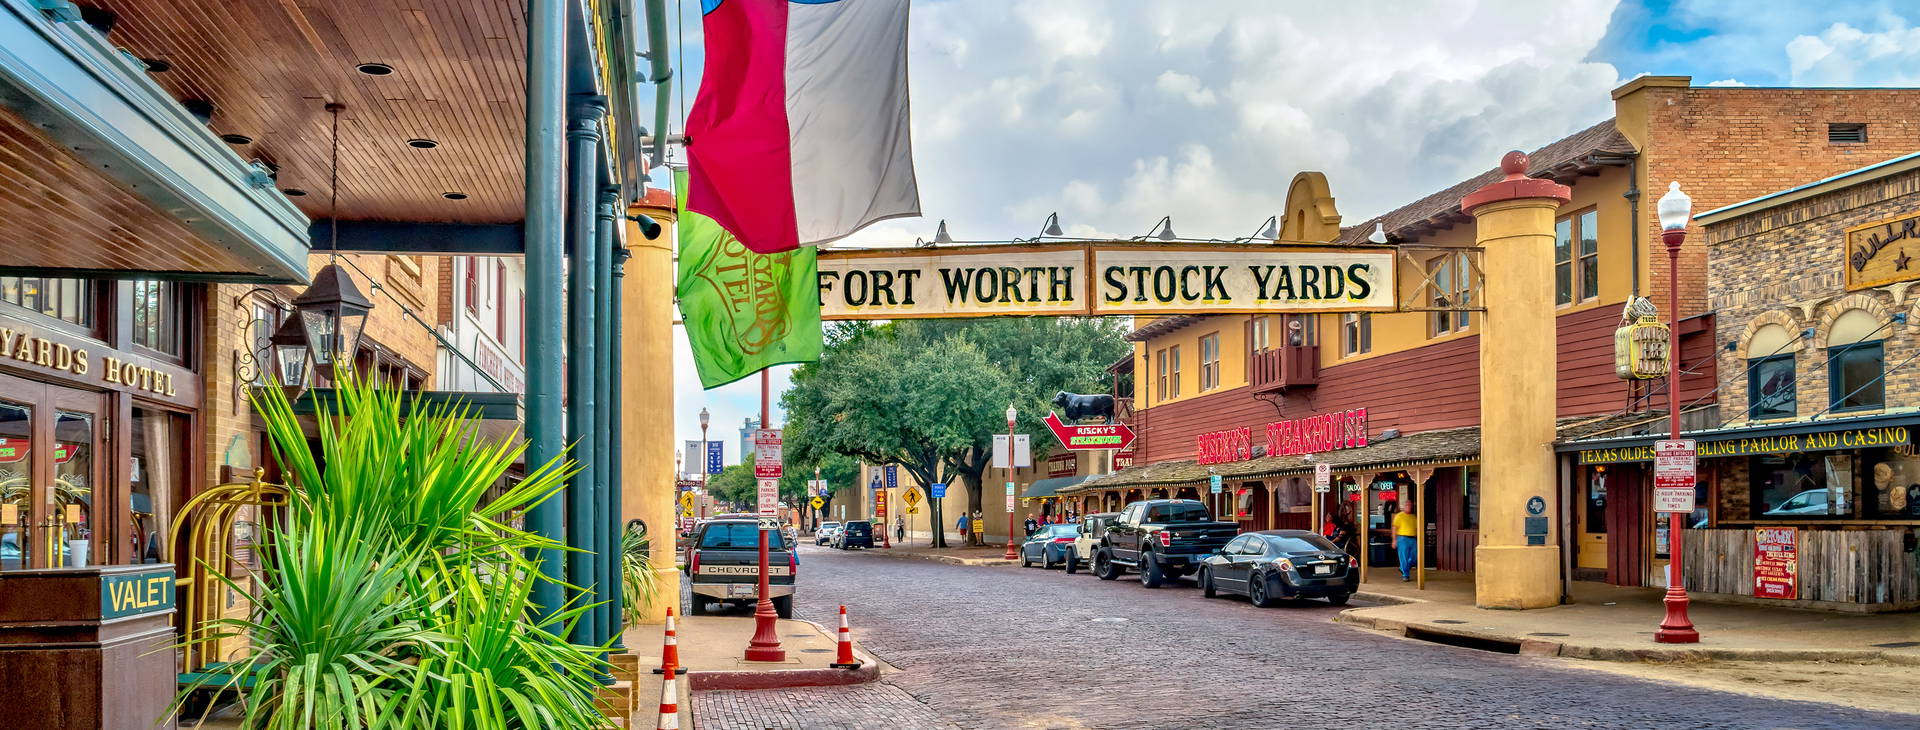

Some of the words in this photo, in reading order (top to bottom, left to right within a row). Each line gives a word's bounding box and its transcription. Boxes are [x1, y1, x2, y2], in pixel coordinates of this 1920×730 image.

[1851, 219, 1920, 272] BULLR
[716, 236, 750, 313] OTEL
[817, 269, 921, 306] FORT
[938, 266, 1075, 305] WORTH
[1104, 265, 1232, 303] STOCK
[1248, 263, 1371, 301] YARDS
[743, 253, 787, 346] KYARDS
[0, 327, 88, 375] YARDS
[105, 356, 176, 397] HOTEL
[1266, 407, 1368, 457] STEAKHOUSE
[1580, 448, 1618, 463] TEXAS
[1620, 446, 1656, 461] OLDES
[1697, 440, 1734, 456] BLING
[1740, 435, 1798, 453] PARLOR
[1805, 432, 1838, 449] AND
[1842, 426, 1907, 447] CASINO
[1115, 458, 1133, 467] TRA
[708, 566, 782, 574] CHEVROET
[108, 576, 171, 612] VALET
